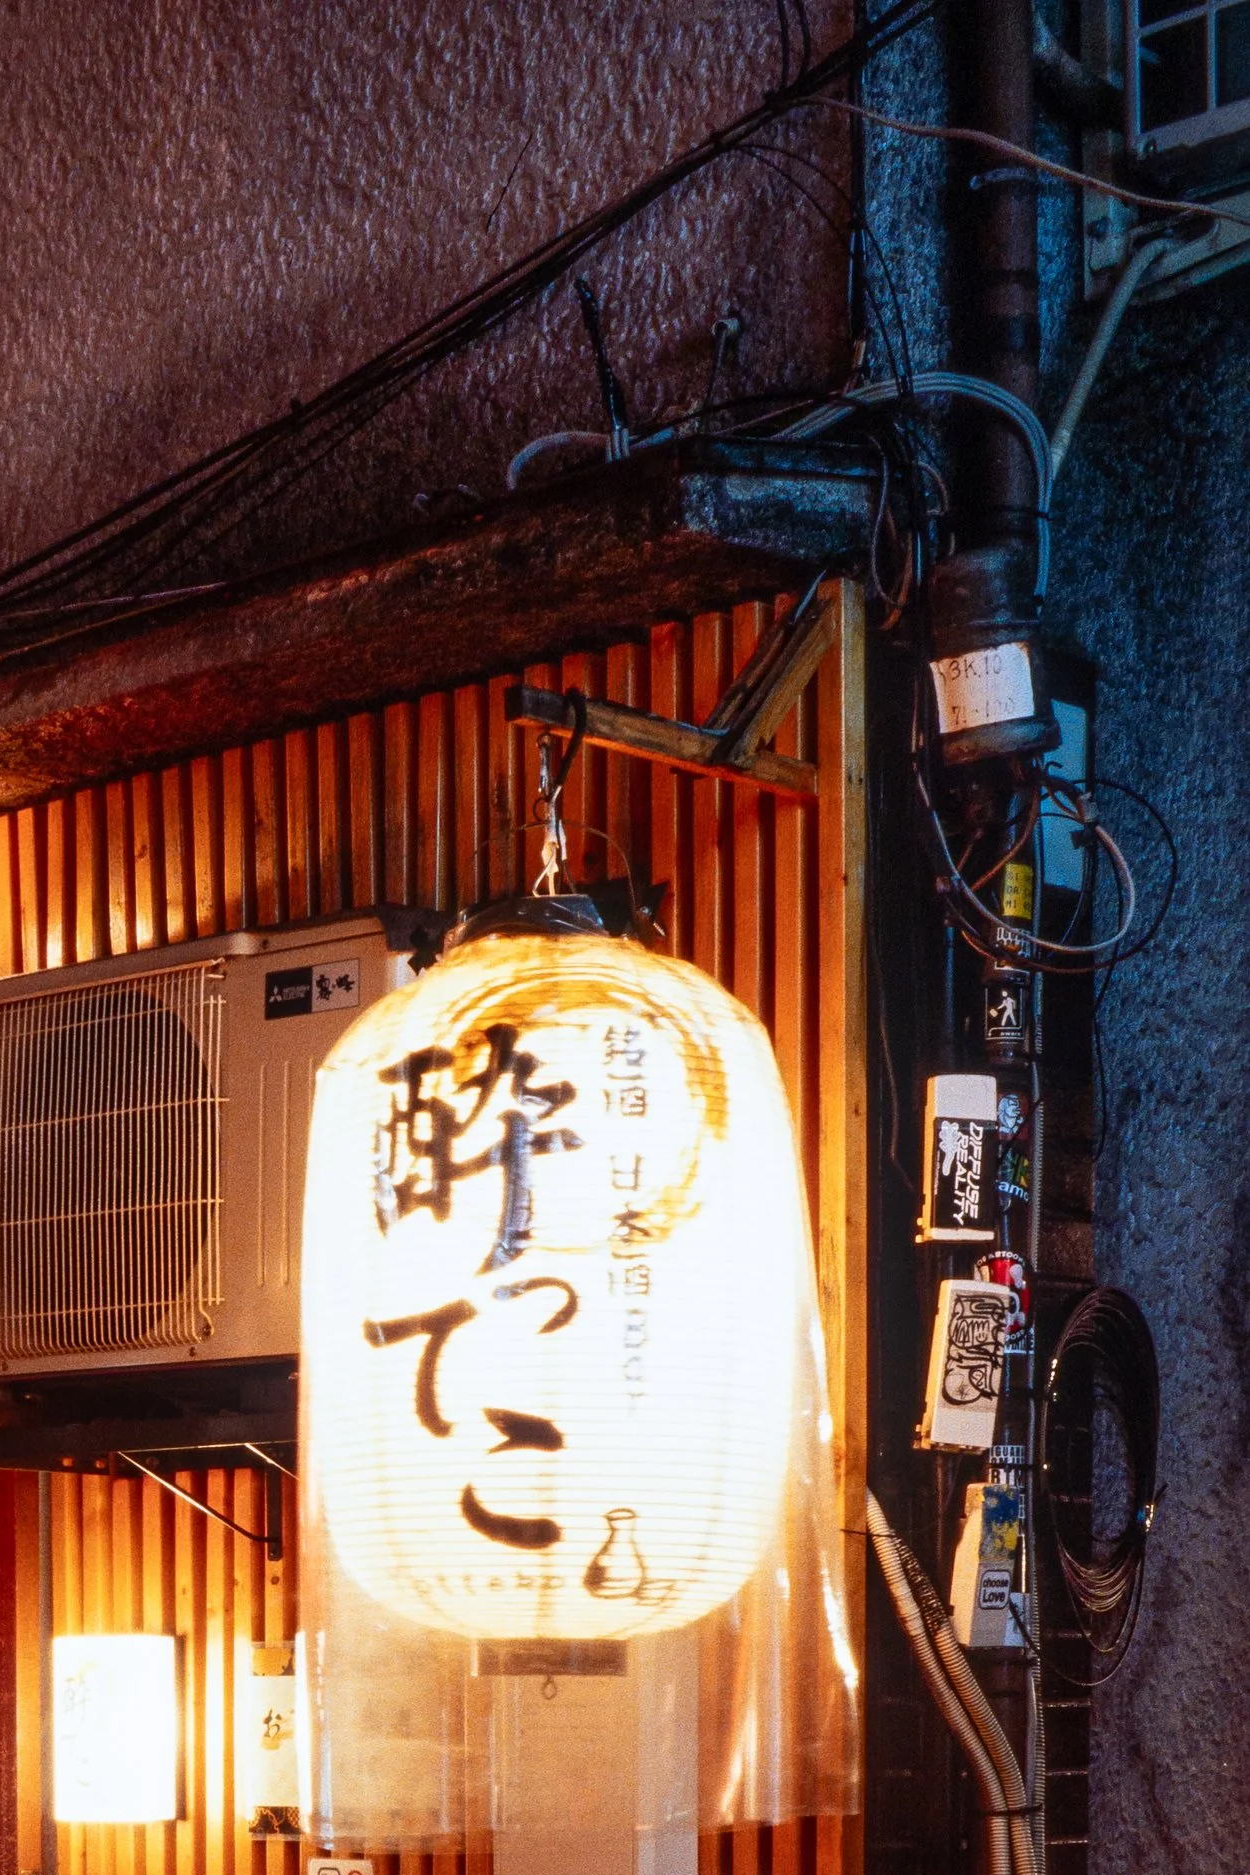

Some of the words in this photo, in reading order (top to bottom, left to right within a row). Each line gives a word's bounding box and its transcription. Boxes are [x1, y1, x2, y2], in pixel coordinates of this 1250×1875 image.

[952, 1132, 969, 1226] REALITY
[964, 1121, 984, 1220] DIFFUSE
[363, 1023, 586, 1549] 酔ってこ
[982, 1589, 1007, 1603] Love
